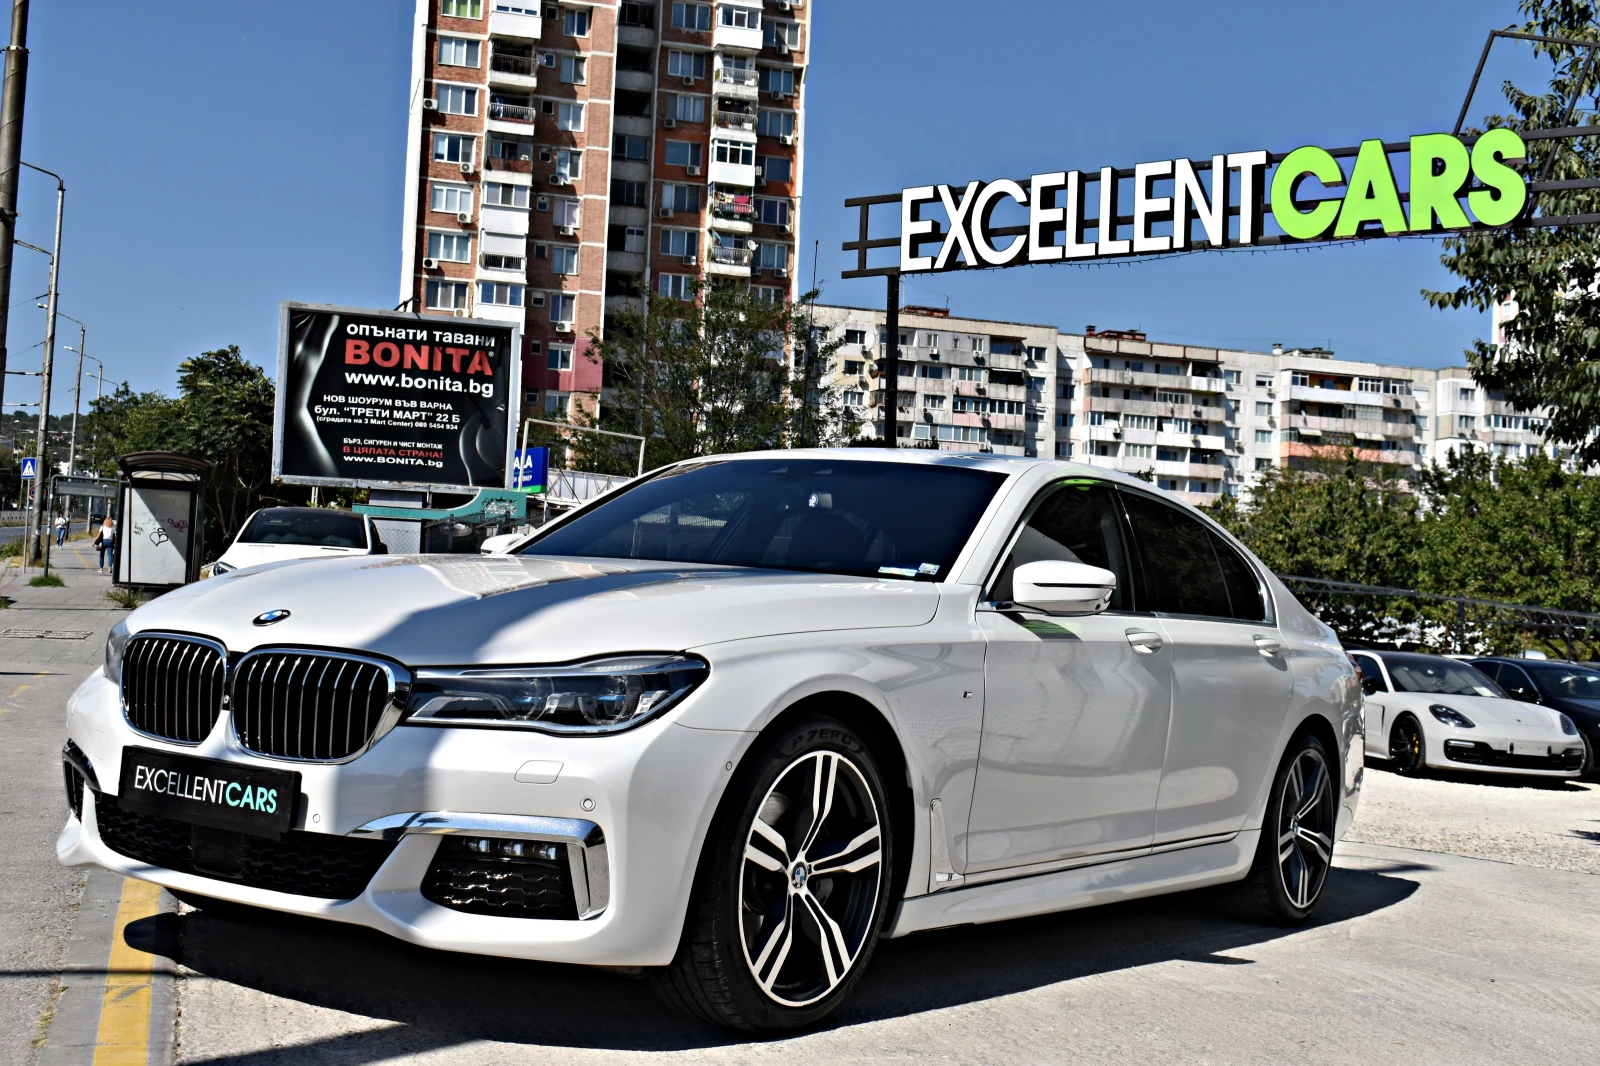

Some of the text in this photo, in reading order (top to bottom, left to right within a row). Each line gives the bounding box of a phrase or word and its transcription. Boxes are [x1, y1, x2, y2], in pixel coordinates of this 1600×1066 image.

[346, 323, 495, 347] опънати тавани
[345, 372, 494, 398] www.bonita.bg
[323, 394, 453, 411] НОВ ШОУРУМ ВЪВ ВАРНА
[314, 404, 340, 416] бул.
[435, 413, 449, 423] 22
[452, 414, 461, 423] Б
[316, 415, 351, 424] (сградата
[370, 418, 386, 426] Mart
[387, 420, 414, 428] Center)
[343, 437, 363, 446] БЪРЗ,
[363, 438, 392, 447] СИГУРЕН
[398, 440, 415, 448] ЧИСТ
[416, 441, 443, 450] МОНТАЖ
[343, 445, 443, 459] В ЦЯЛАТА СТРАНА!
[343, 455, 443, 468] www.BONITA.bg
